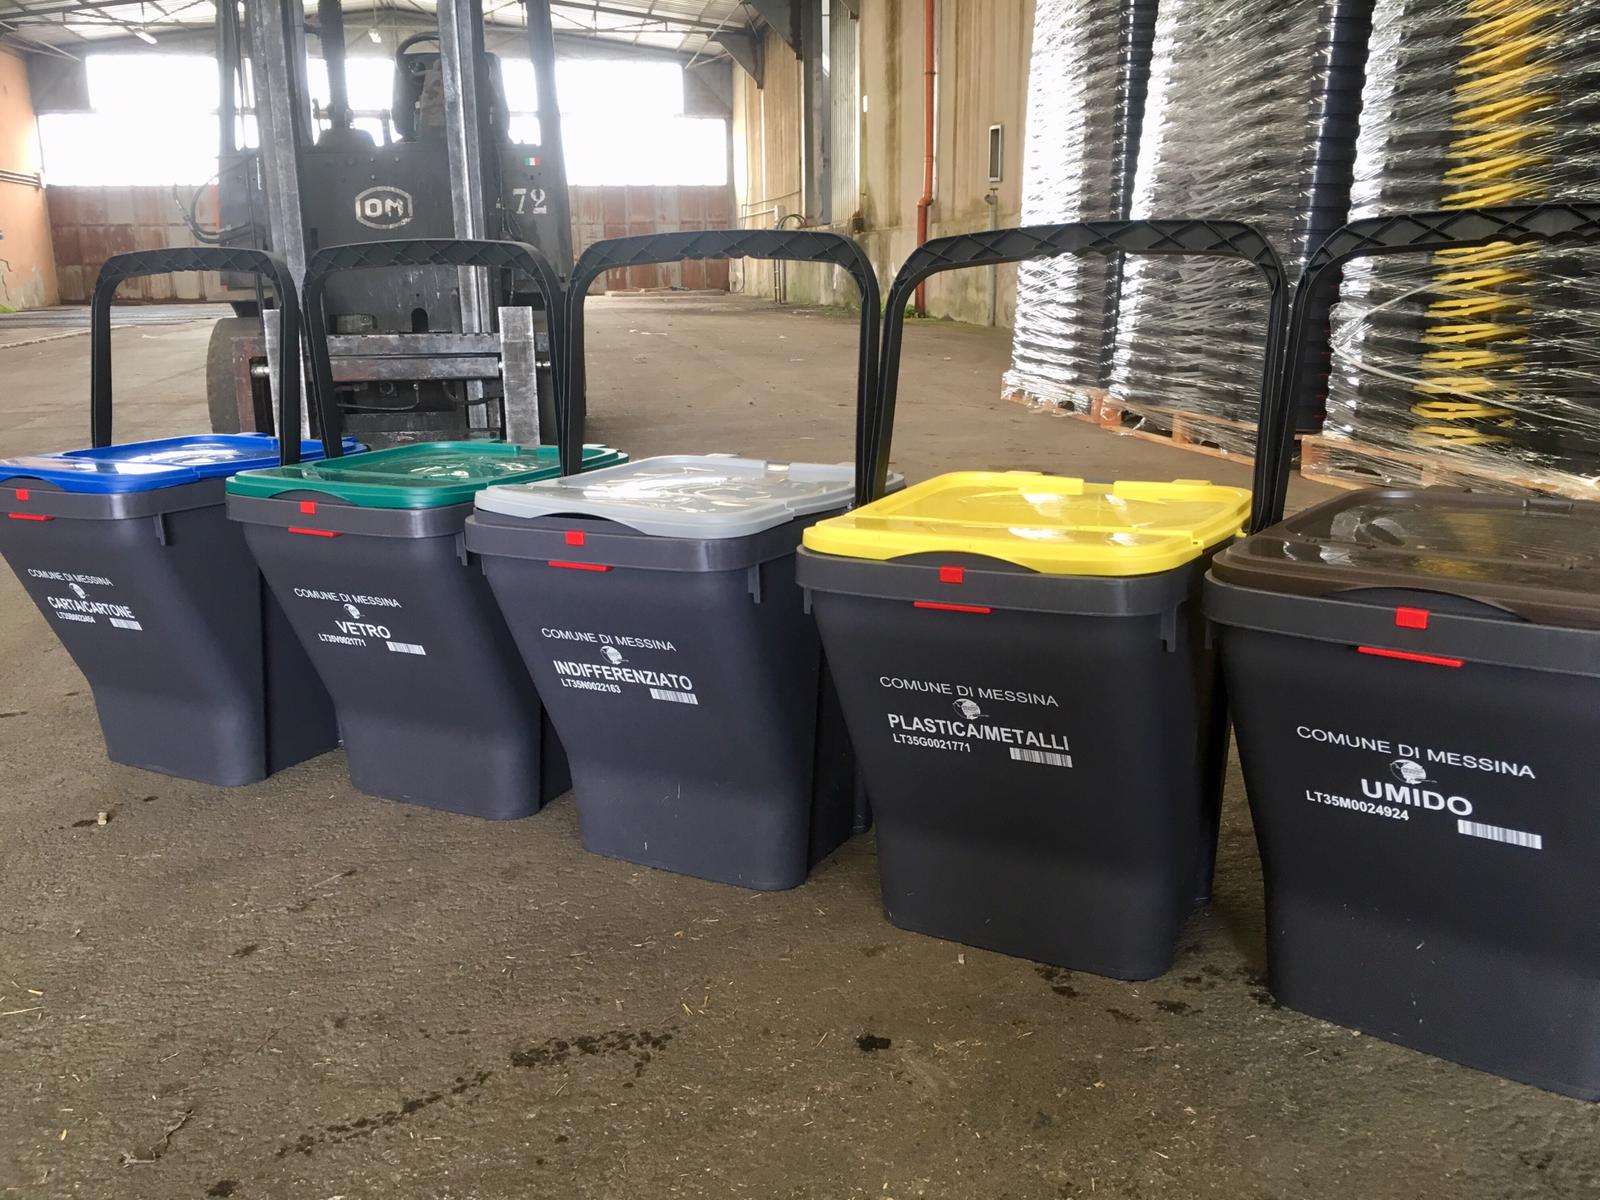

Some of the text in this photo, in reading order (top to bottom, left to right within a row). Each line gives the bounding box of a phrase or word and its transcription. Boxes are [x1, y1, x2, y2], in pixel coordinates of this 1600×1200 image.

[364, 197, 404, 218] OM
[512, 187, 547, 215] 72
[27, 568, 114, 587] COMUNE DI MESSINA
[47, 596, 135, 619] CARTA/CARTONE
[293, 587, 402, 608] COMUNE DI MESSINA
[335, 620, 392, 639] VETRO
[541, 627, 677, 652] COMUNE DI MESSINA
[552, 660, 693, 691] INDIFFERENZIATO
[879, 676, 1059, 707] COMUNE DI MESSINA
[887, 713, 1070, 751] PLASTICA/METALLI
[892, 733, 971, 753] LT35G0021771
[1296, 726, 1536, 779] COMUNE DI MESSINA
[1305, 789, 1410, 821] LT35M0024924
[1361, 778, 1473, 816] UMIDO
